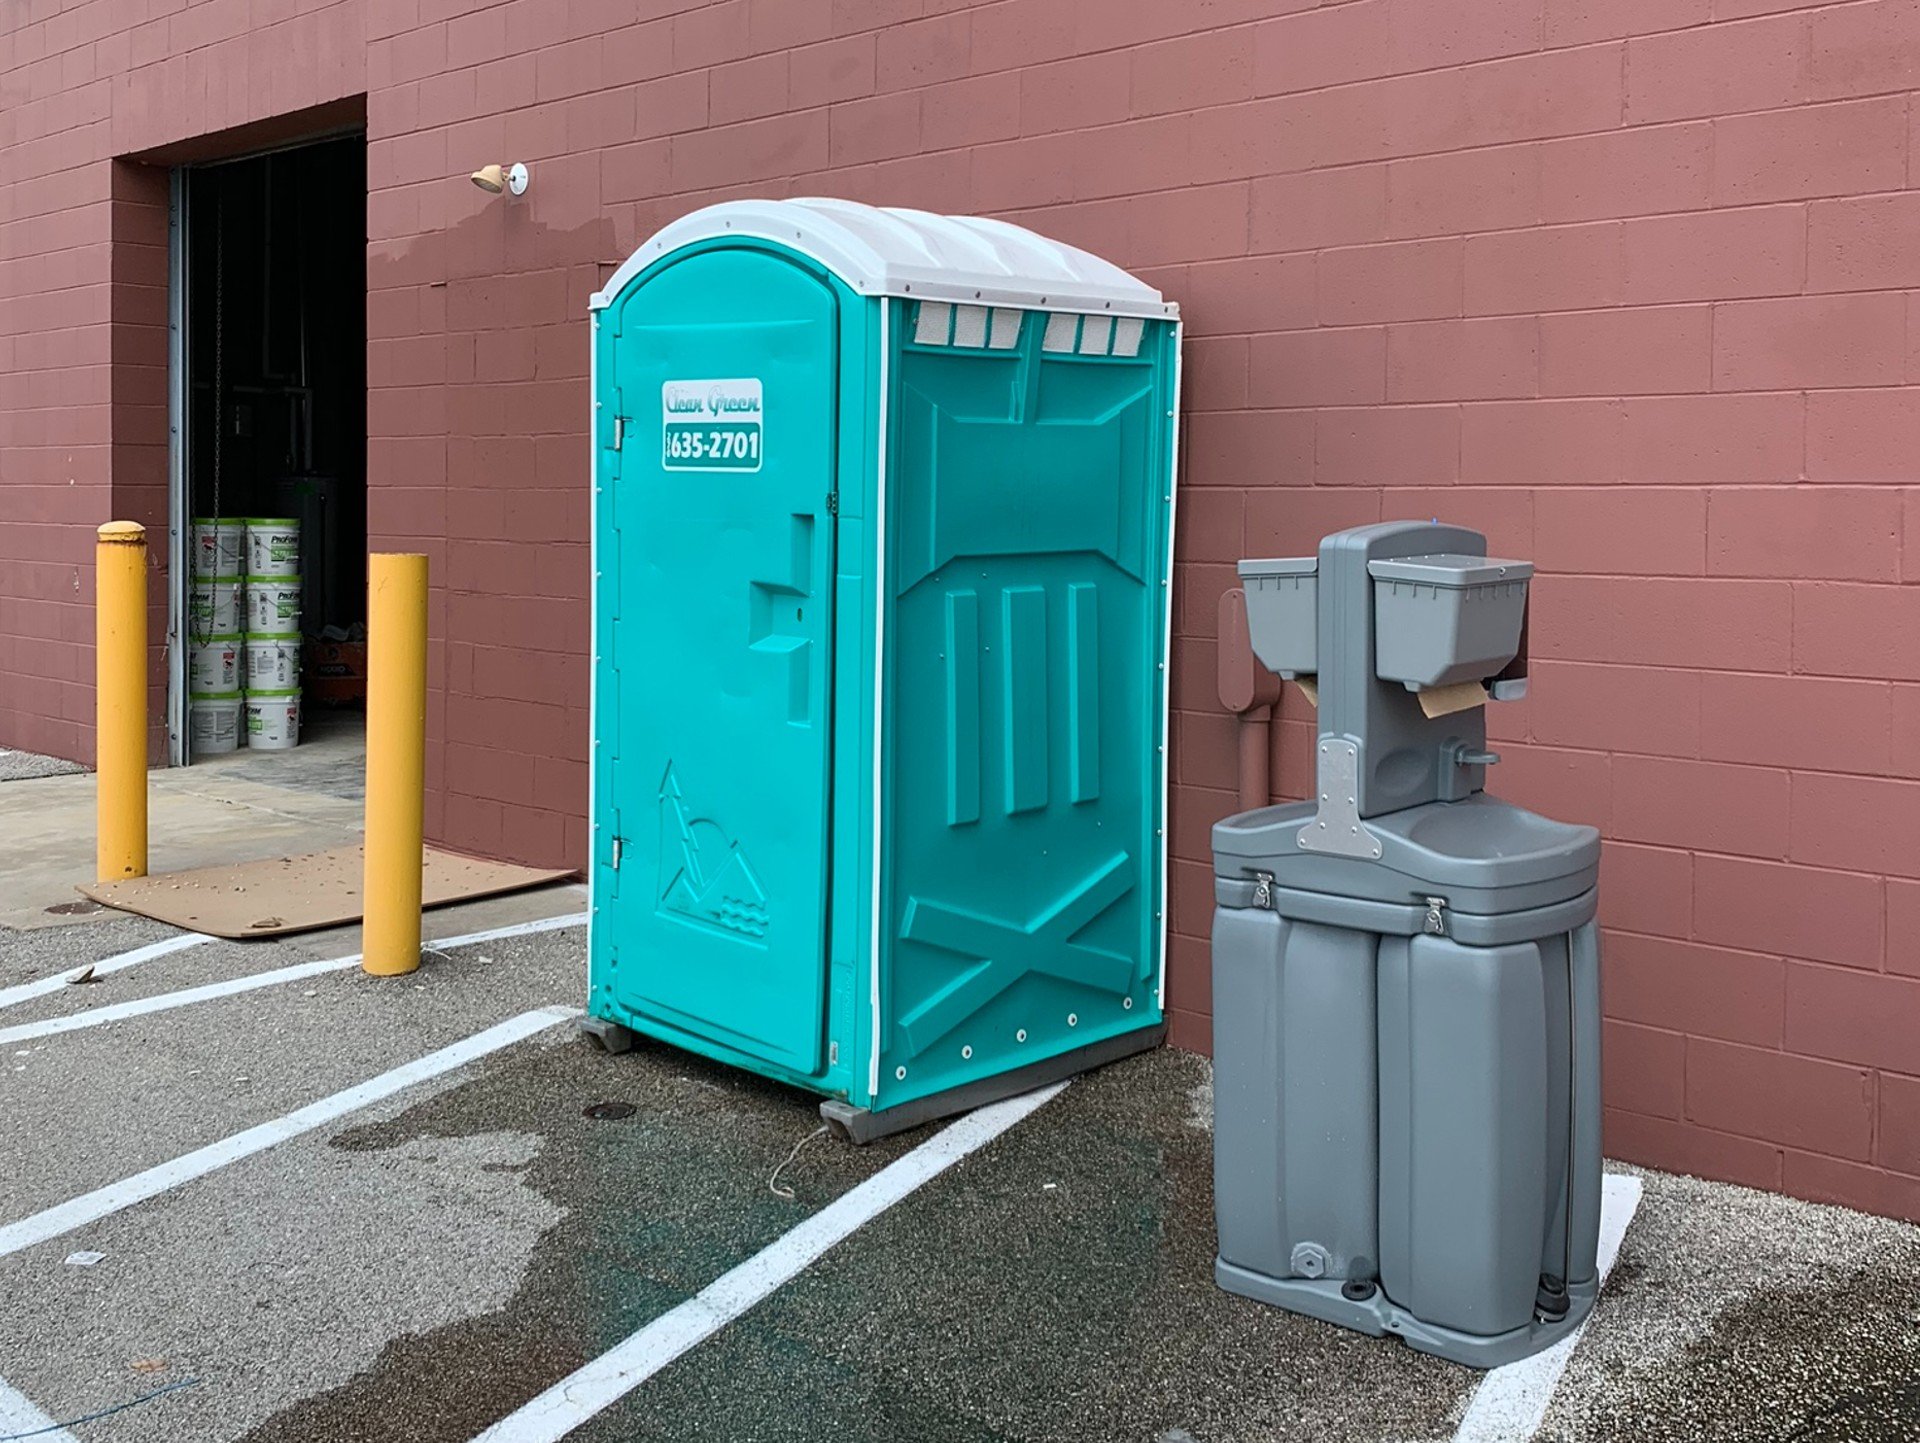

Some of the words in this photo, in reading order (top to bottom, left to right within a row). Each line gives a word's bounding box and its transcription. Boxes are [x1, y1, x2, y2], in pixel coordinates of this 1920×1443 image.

[666, 386, 704, 413] Clean
[707, 385, 760, 417] Green
[671, 431, 759, 459] 635-2701
